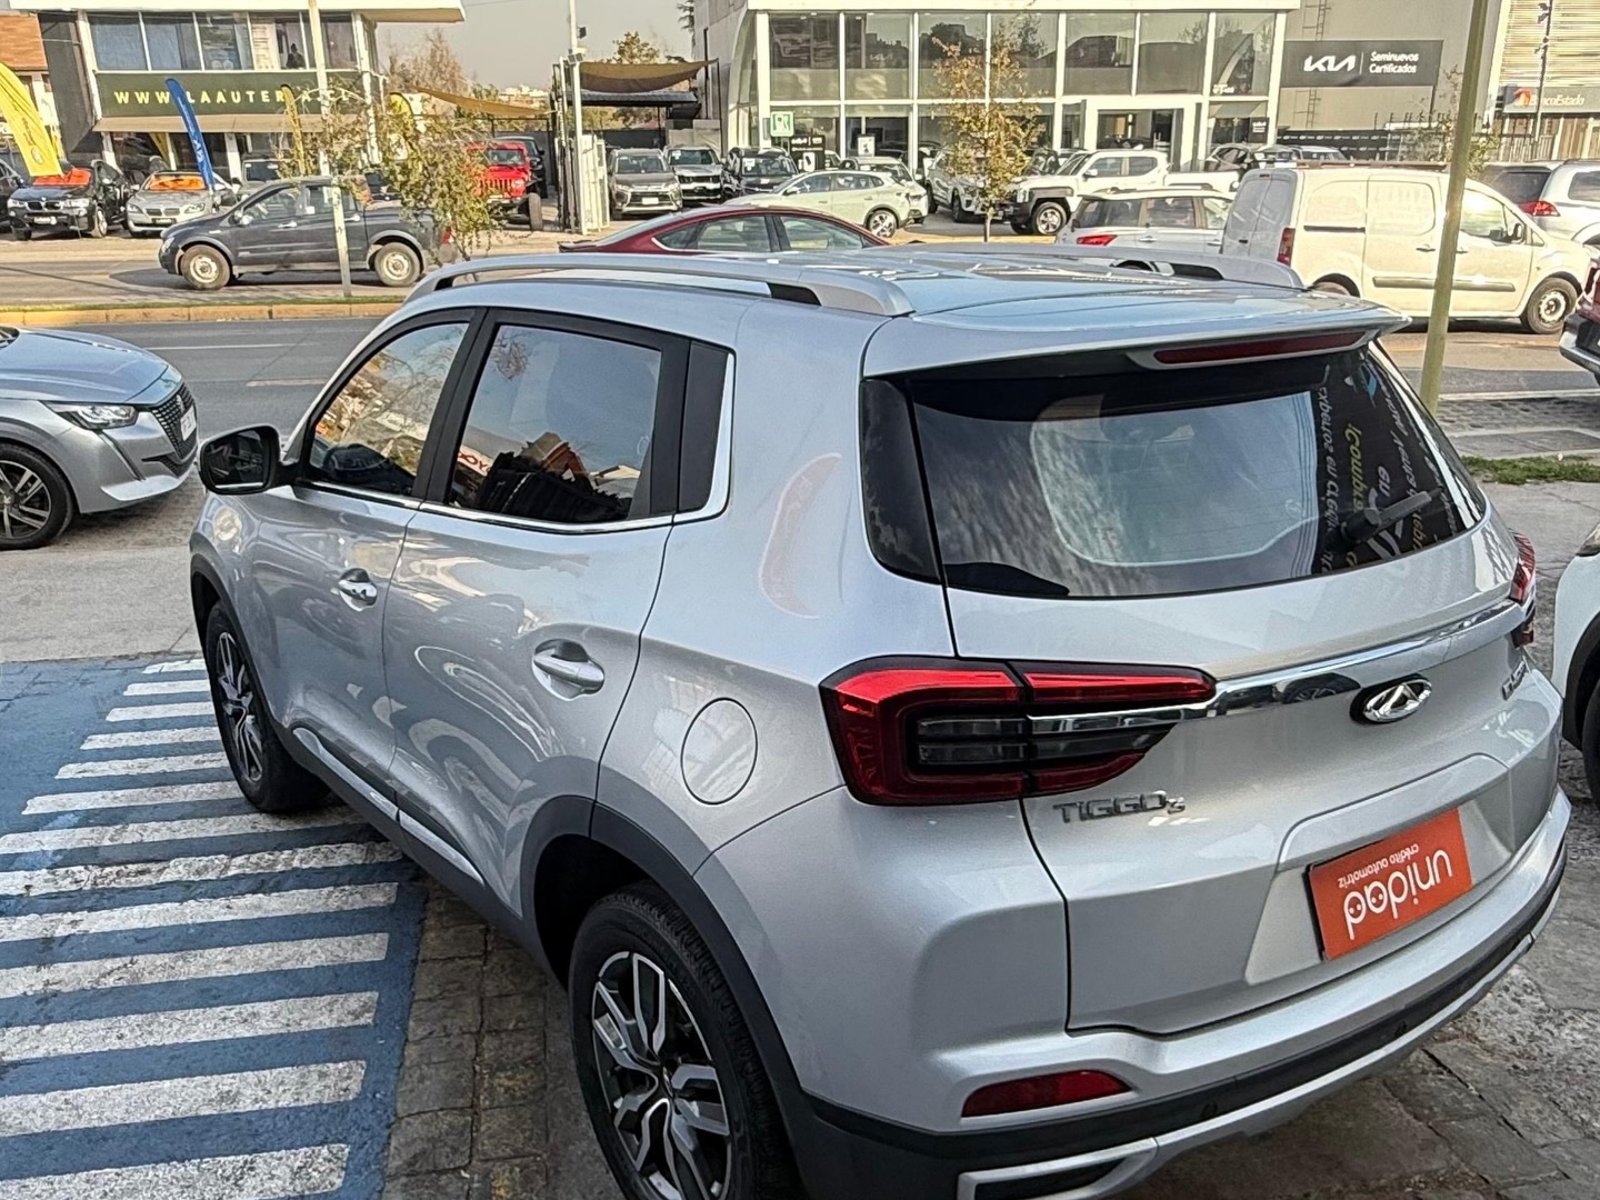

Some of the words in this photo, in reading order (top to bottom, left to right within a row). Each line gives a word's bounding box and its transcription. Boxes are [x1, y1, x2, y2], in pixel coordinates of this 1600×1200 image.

[1303, 54, 1356, 72] KIA
[1370, 51, 1419, 62] Seminuevos
[1369, 63, 1417, 74] Certificados
[1530, 94, 1585, 106] BncoEstado
[1337, 858, 1389, 889] automotriz
[1343, 849, 1454, 941] unidad
